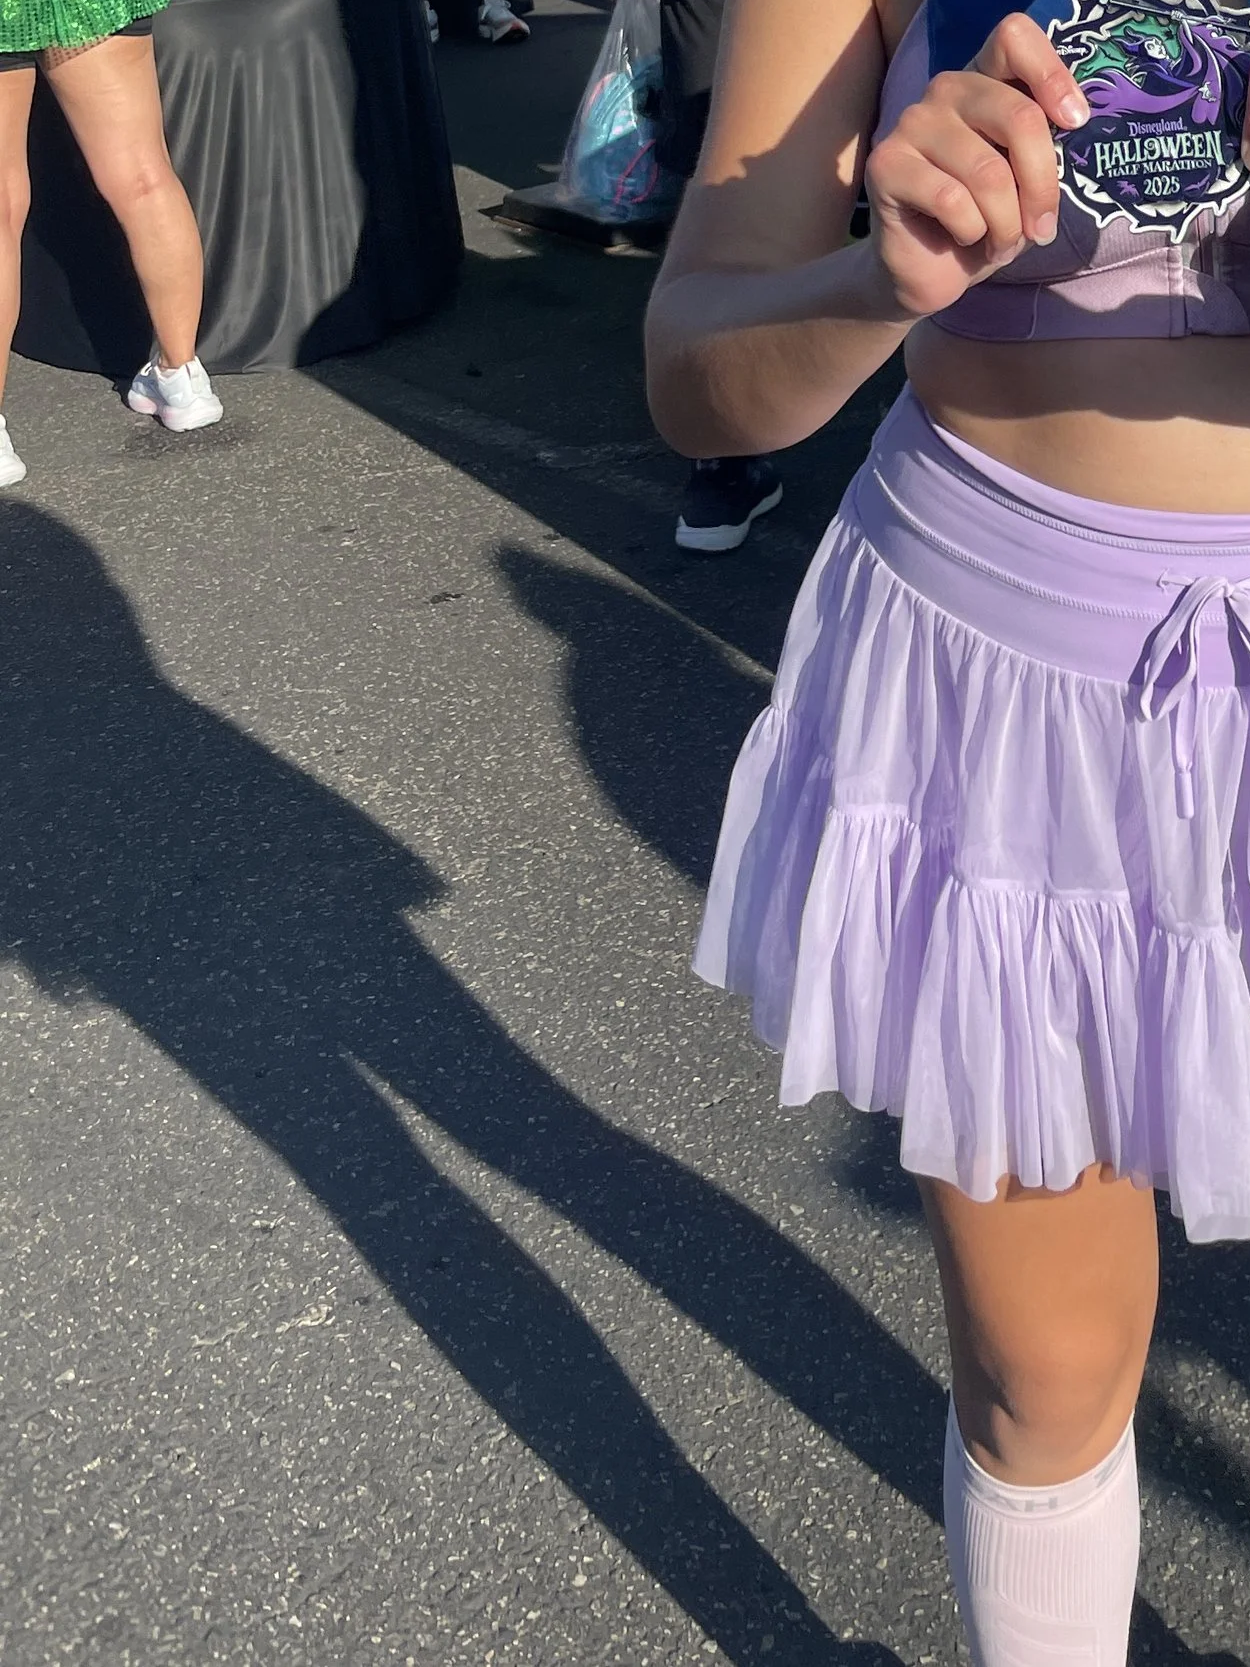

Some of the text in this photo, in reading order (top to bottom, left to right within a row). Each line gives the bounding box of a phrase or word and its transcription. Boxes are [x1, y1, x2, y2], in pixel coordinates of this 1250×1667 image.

[1094, 130, 1227, 178] HALLOWEEN
[1108, 159, 1213, 179] HALF MARATHON
[1143, 175, 1181, 196] 2025
